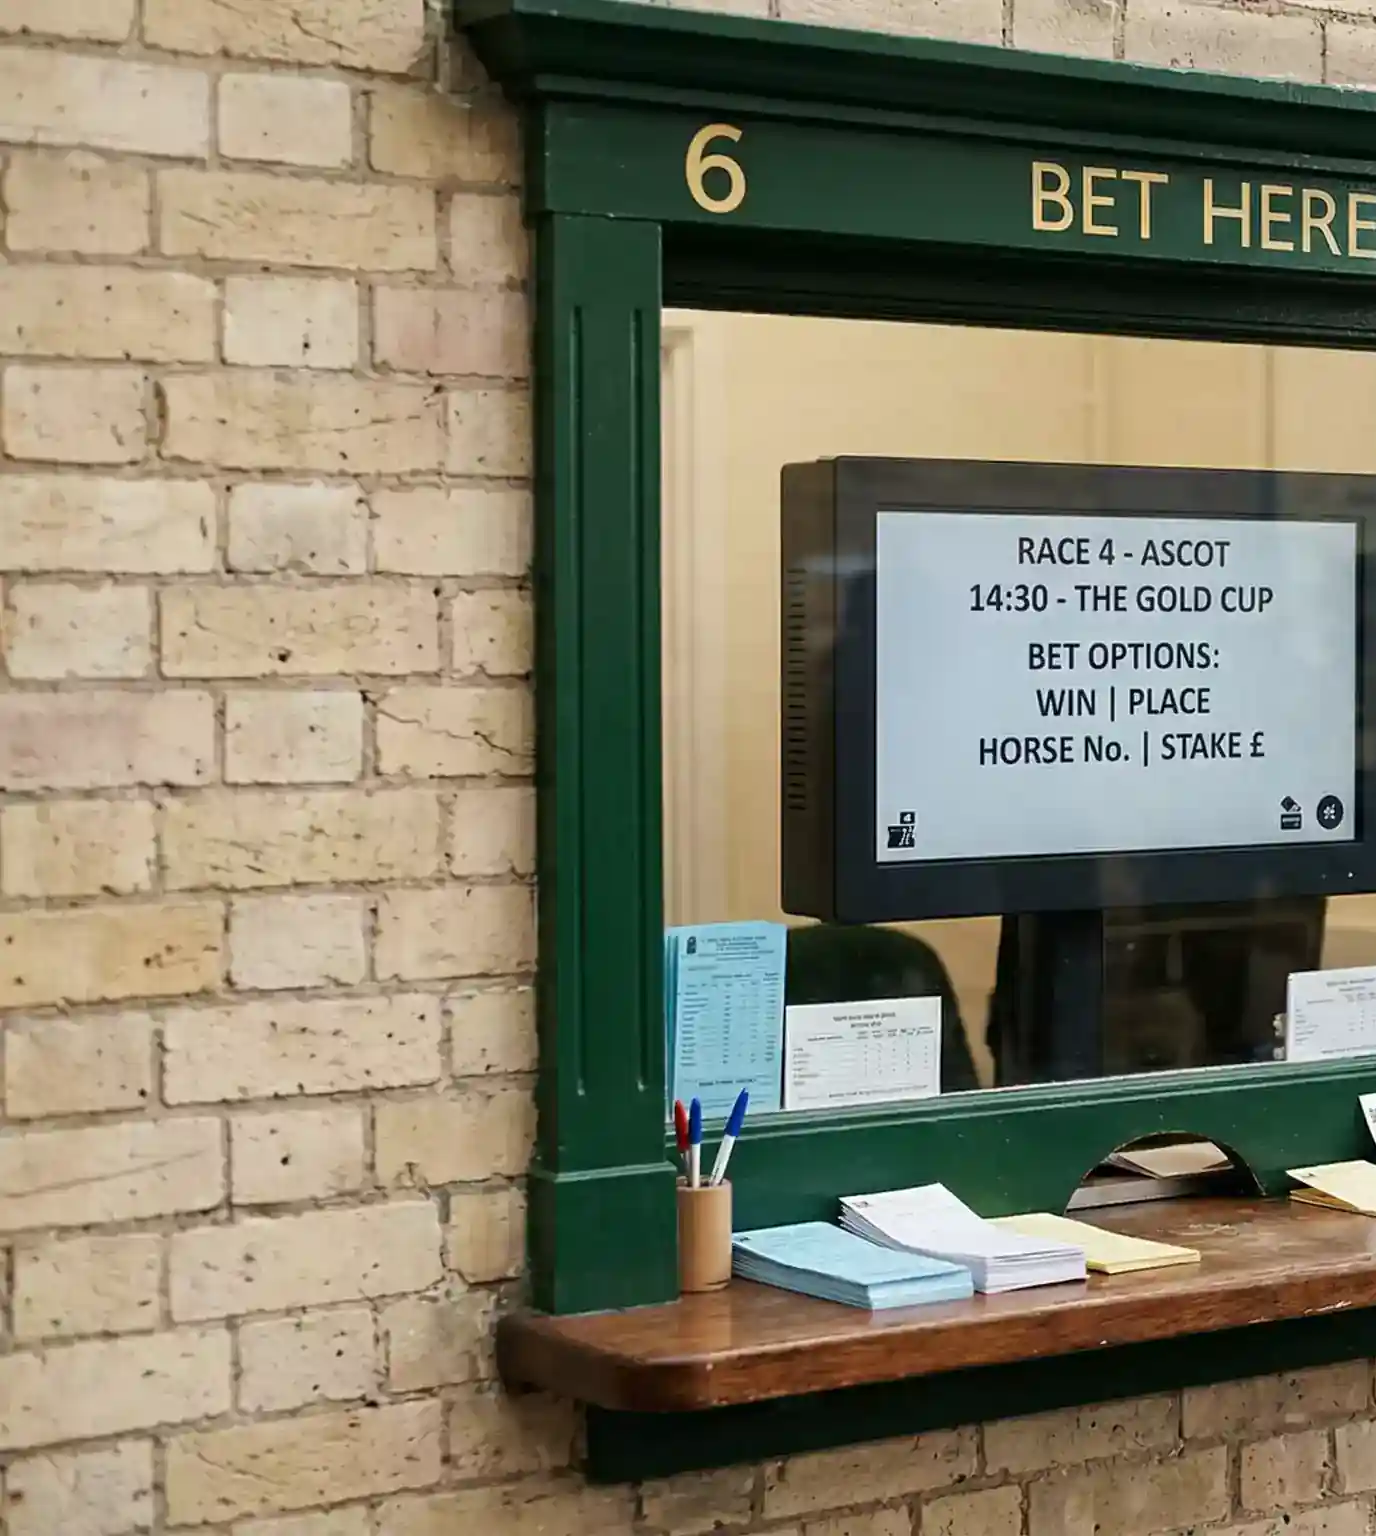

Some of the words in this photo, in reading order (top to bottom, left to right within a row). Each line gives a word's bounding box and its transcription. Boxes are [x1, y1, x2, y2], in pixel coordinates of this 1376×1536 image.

[685, 124, 746, 214] 6
[1032, 161, 1169, 240] BET
[1018, 536, 1090, 565] RACE
[1098, 538, 1116, 566] 4
[1140, 539, 1231, 568] ASCOT
[970, 583, 1048, 613] 14:30
[1074, 584, 1128, 612] THE
[1136, 585, 1212, 613] GOLD
[1220, 586, 1274, 613] CUP
[1028, 642, 1081, 670] BET
[1088, 642, 1219, 670] OPTIONS:
[1036, 688, 1096, 717] WIN
[1129, 687, 1211, 715] PLACE
[979, 736, 1074, 766] HORSE
[1084, 735, 1130, 763] No.
[1161, 731, 1242, 761] STAKE
[1249, 731, 1265, 758] £
